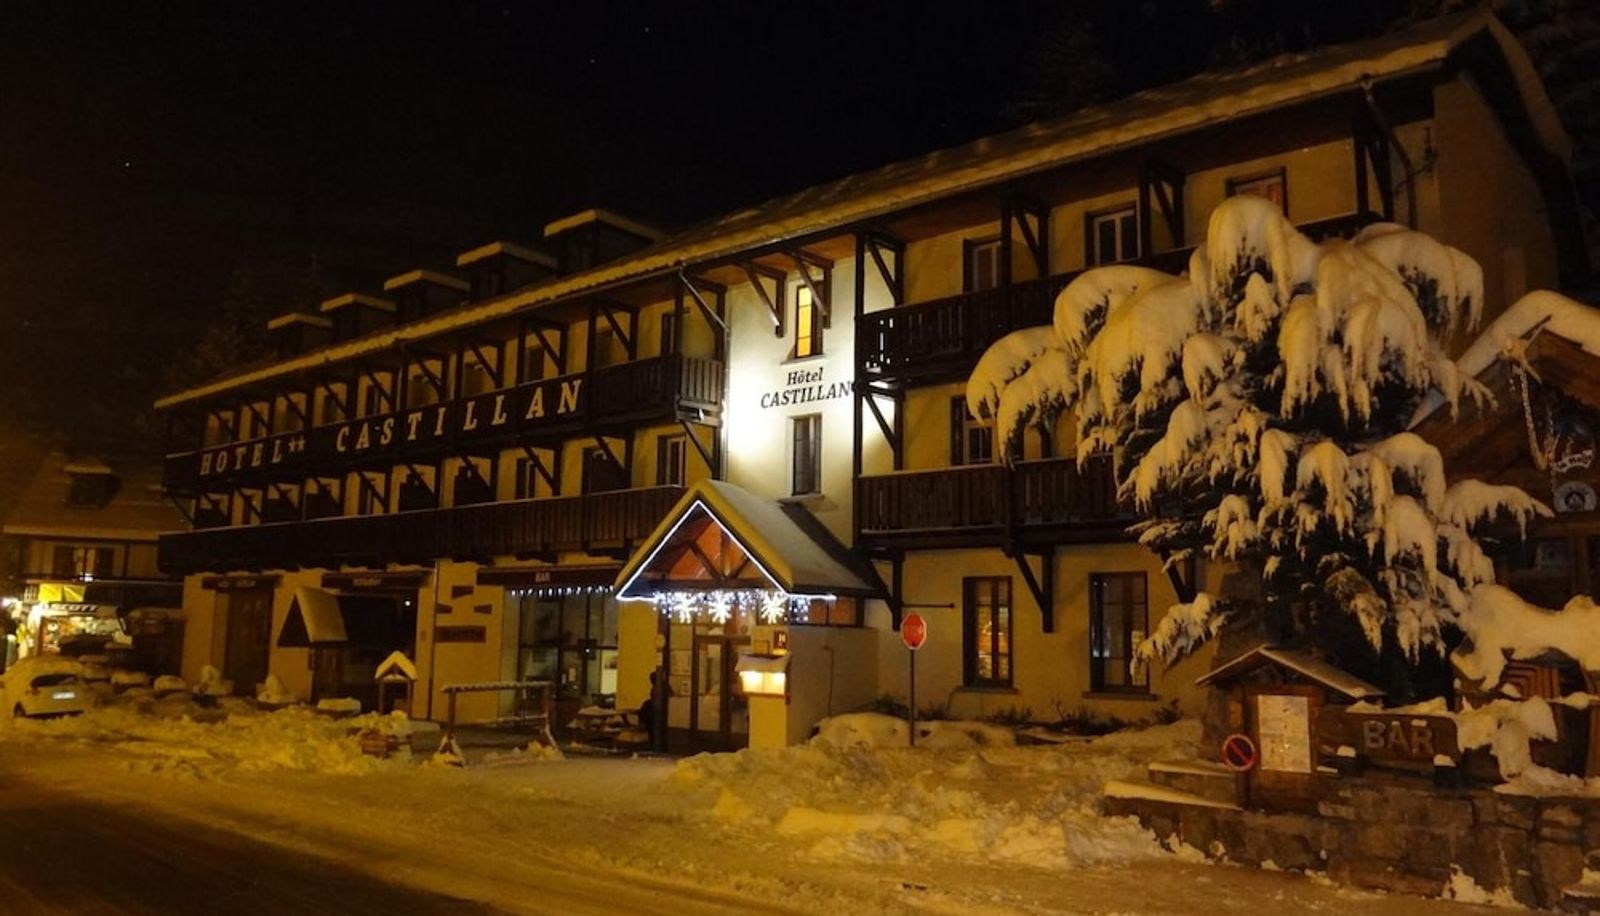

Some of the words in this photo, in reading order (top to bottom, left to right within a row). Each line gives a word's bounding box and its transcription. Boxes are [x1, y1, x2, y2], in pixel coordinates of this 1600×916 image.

[787, 367, 824, 386] Hôtel
[760, 380, 851, 408] CASTILLAN
[199, 440, 284, 477] HOTEL
[334, 377, 584, 453] CASTILLAN
[1363, 719, 1434, 755] BAR
